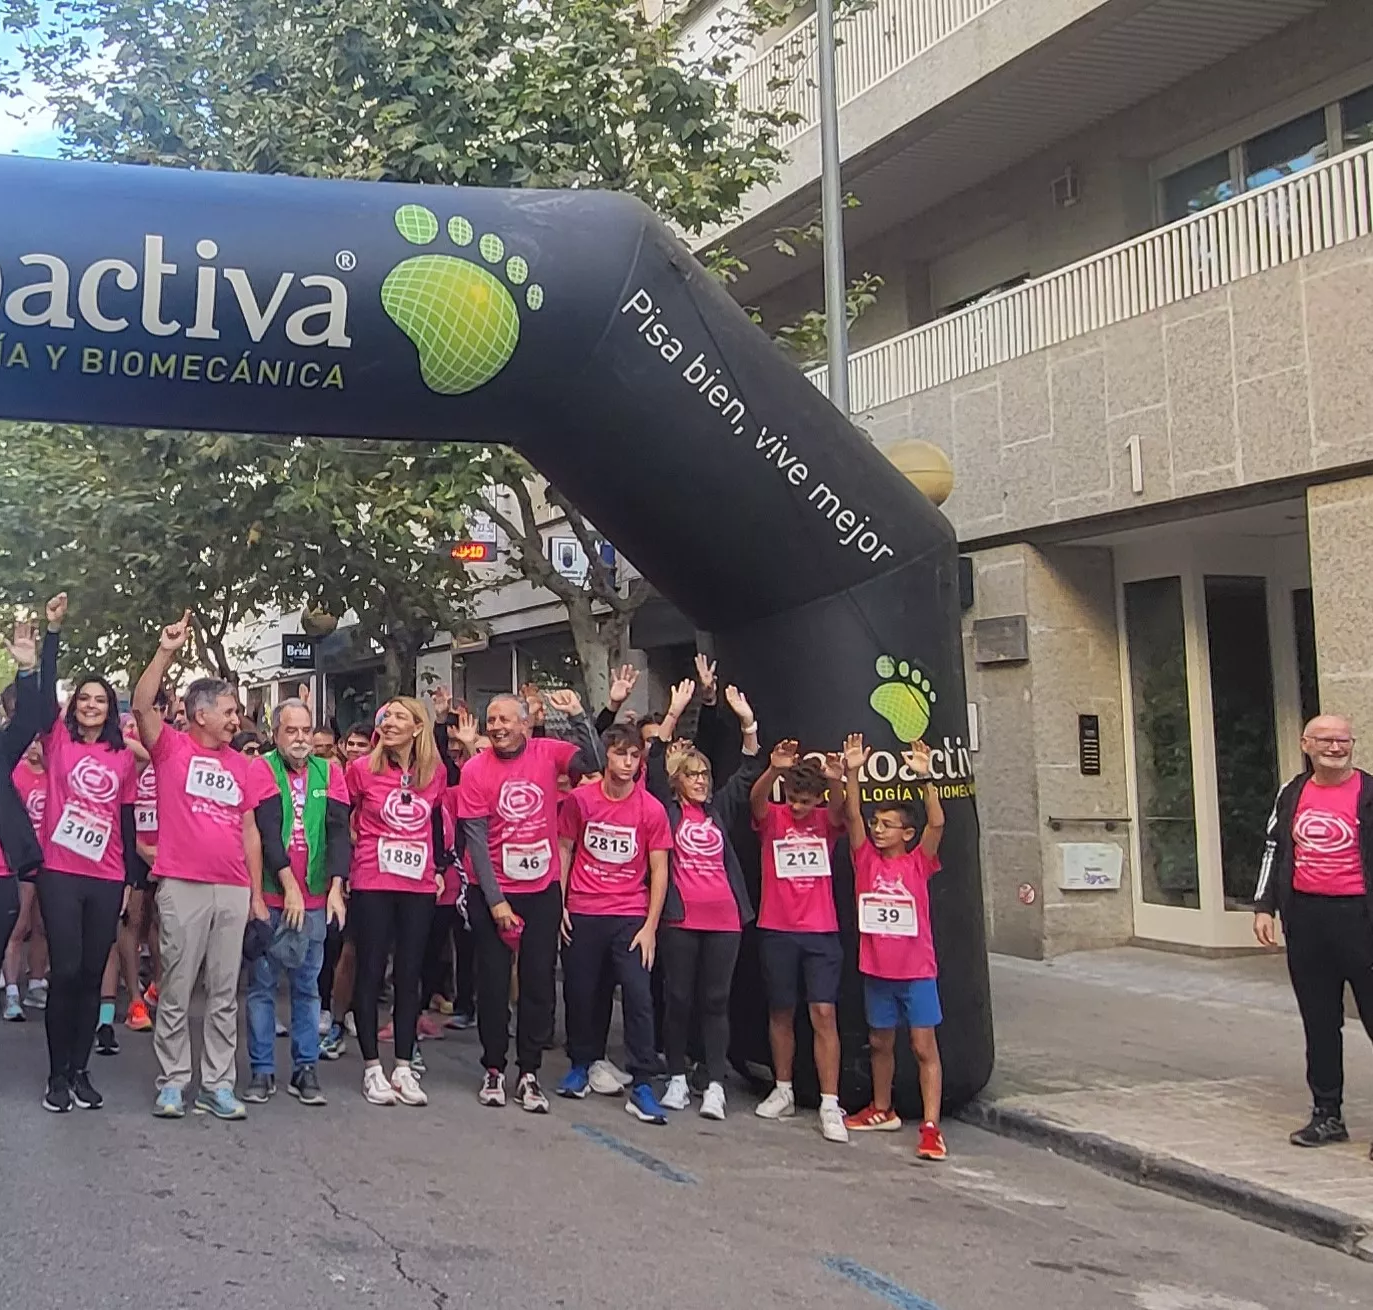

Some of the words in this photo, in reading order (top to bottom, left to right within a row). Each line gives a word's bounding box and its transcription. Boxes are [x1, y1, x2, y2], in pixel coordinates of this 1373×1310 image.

[46, 345, 68, 371] Y
[82, 348, 345, 390] BIOMECÁNICA
[621, 289, 683, 363] Pisa
[682, 353, 747, 435] bien,
[755, 426, 810, 486] vive
[808, 483, 894, 562] mejor
[63, 819, 104, 847] 3109
[589, 835, 629, 854] 2815
[384, 848, 422, 867] 1889
[519, 856, 540, 870] 46
[786, 851, 819, 867] 212
[877, 908, 900, 923] 39
